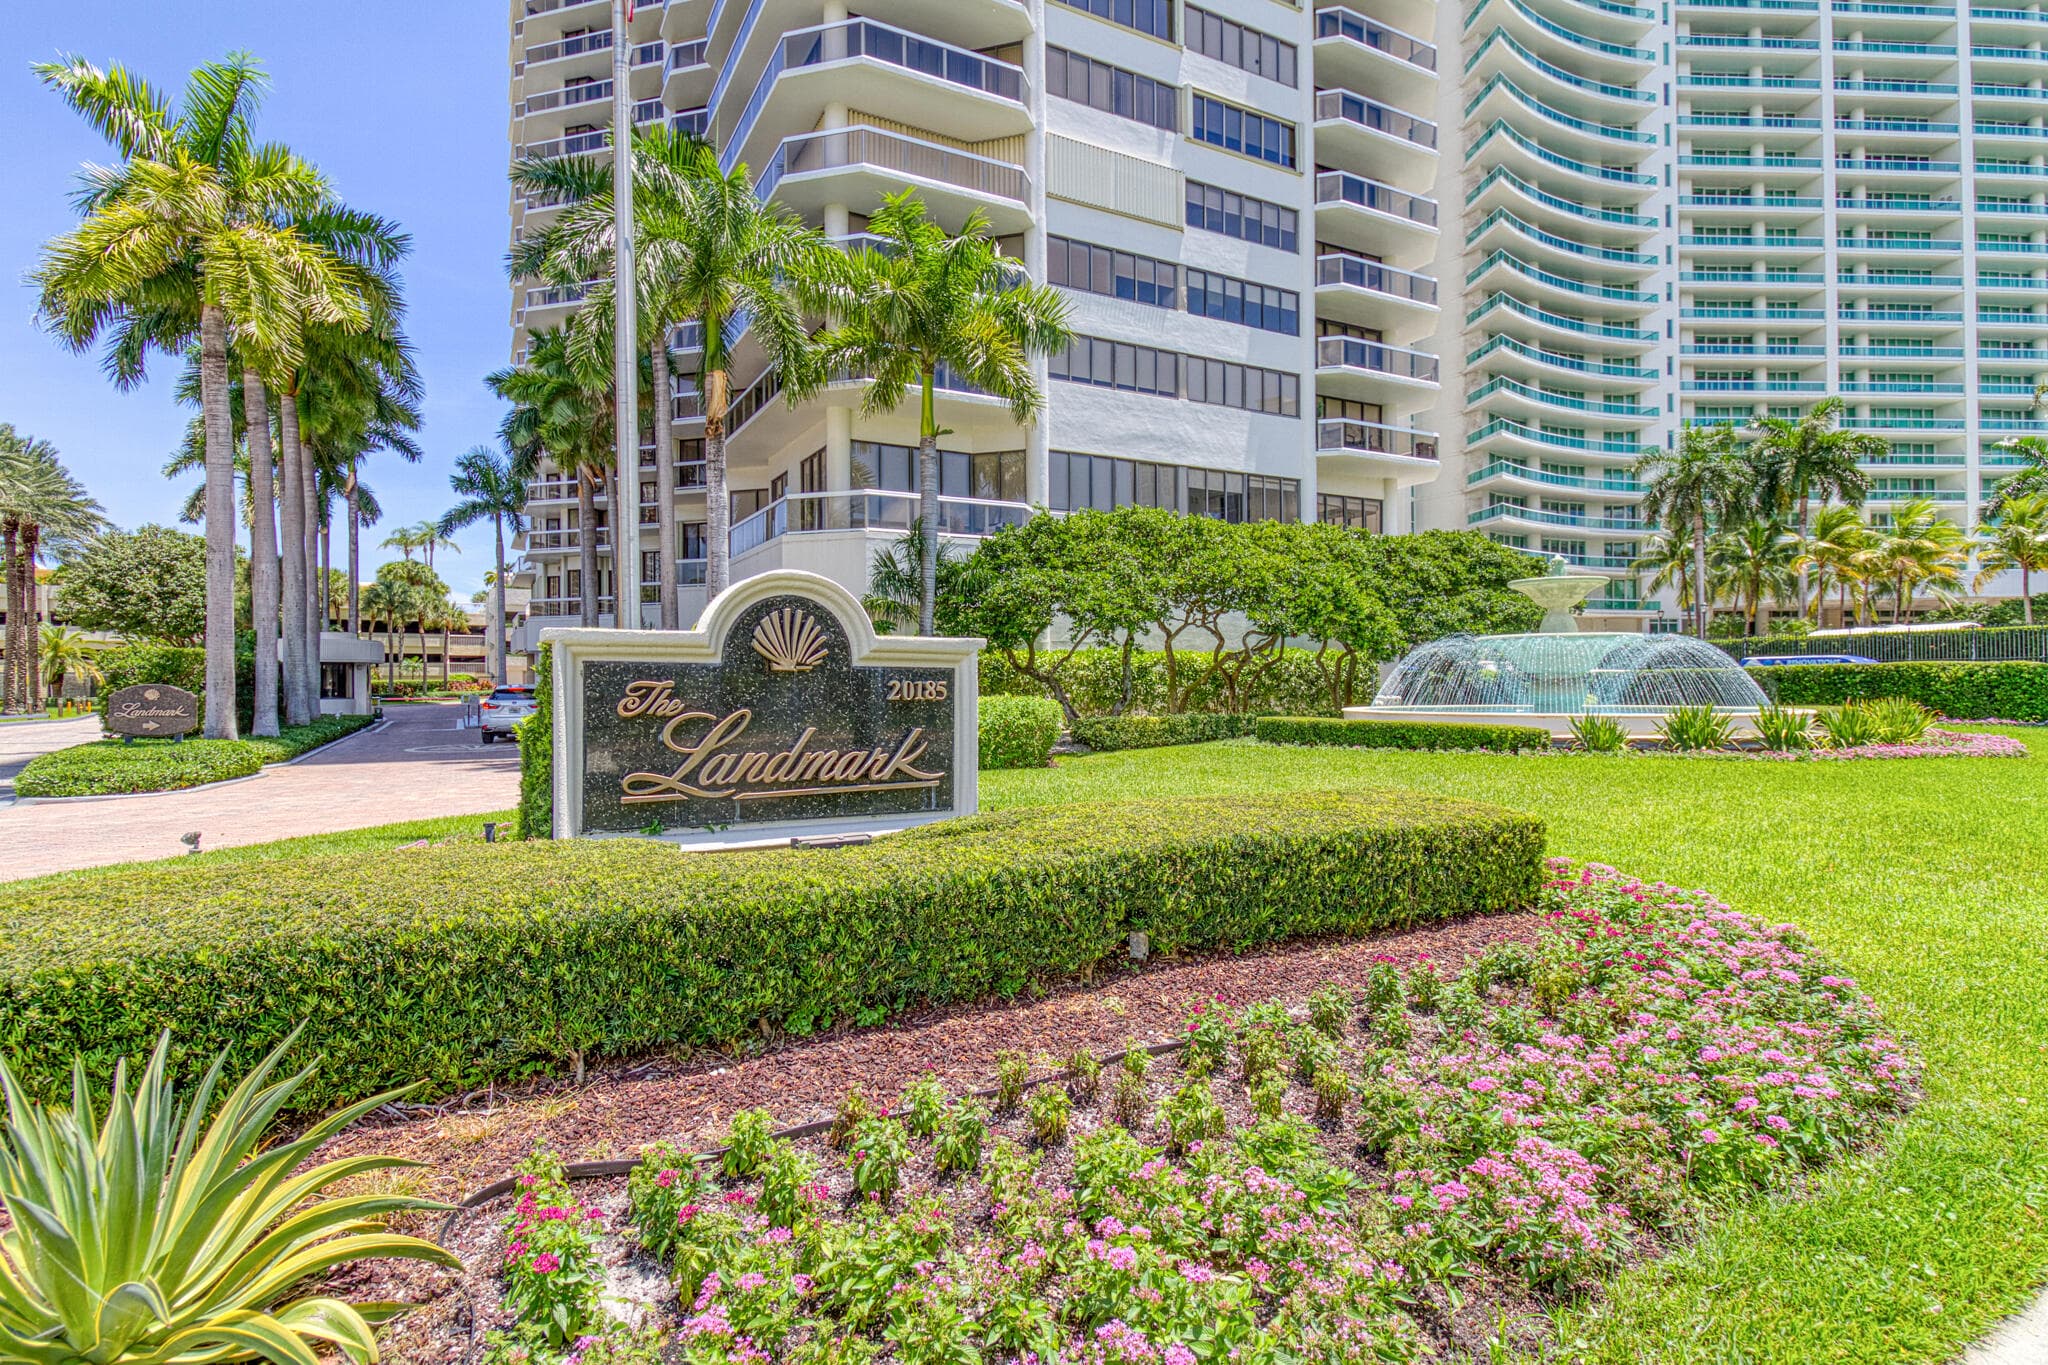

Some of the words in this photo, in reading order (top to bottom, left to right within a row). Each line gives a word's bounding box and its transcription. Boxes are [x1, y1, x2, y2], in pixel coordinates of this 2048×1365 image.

[617, 680, 684, 718] The
[887, 680, 948, 701] 20185
[114, 702, 190, 719] Landmark
[622, 709, 945, 798] Landmark
